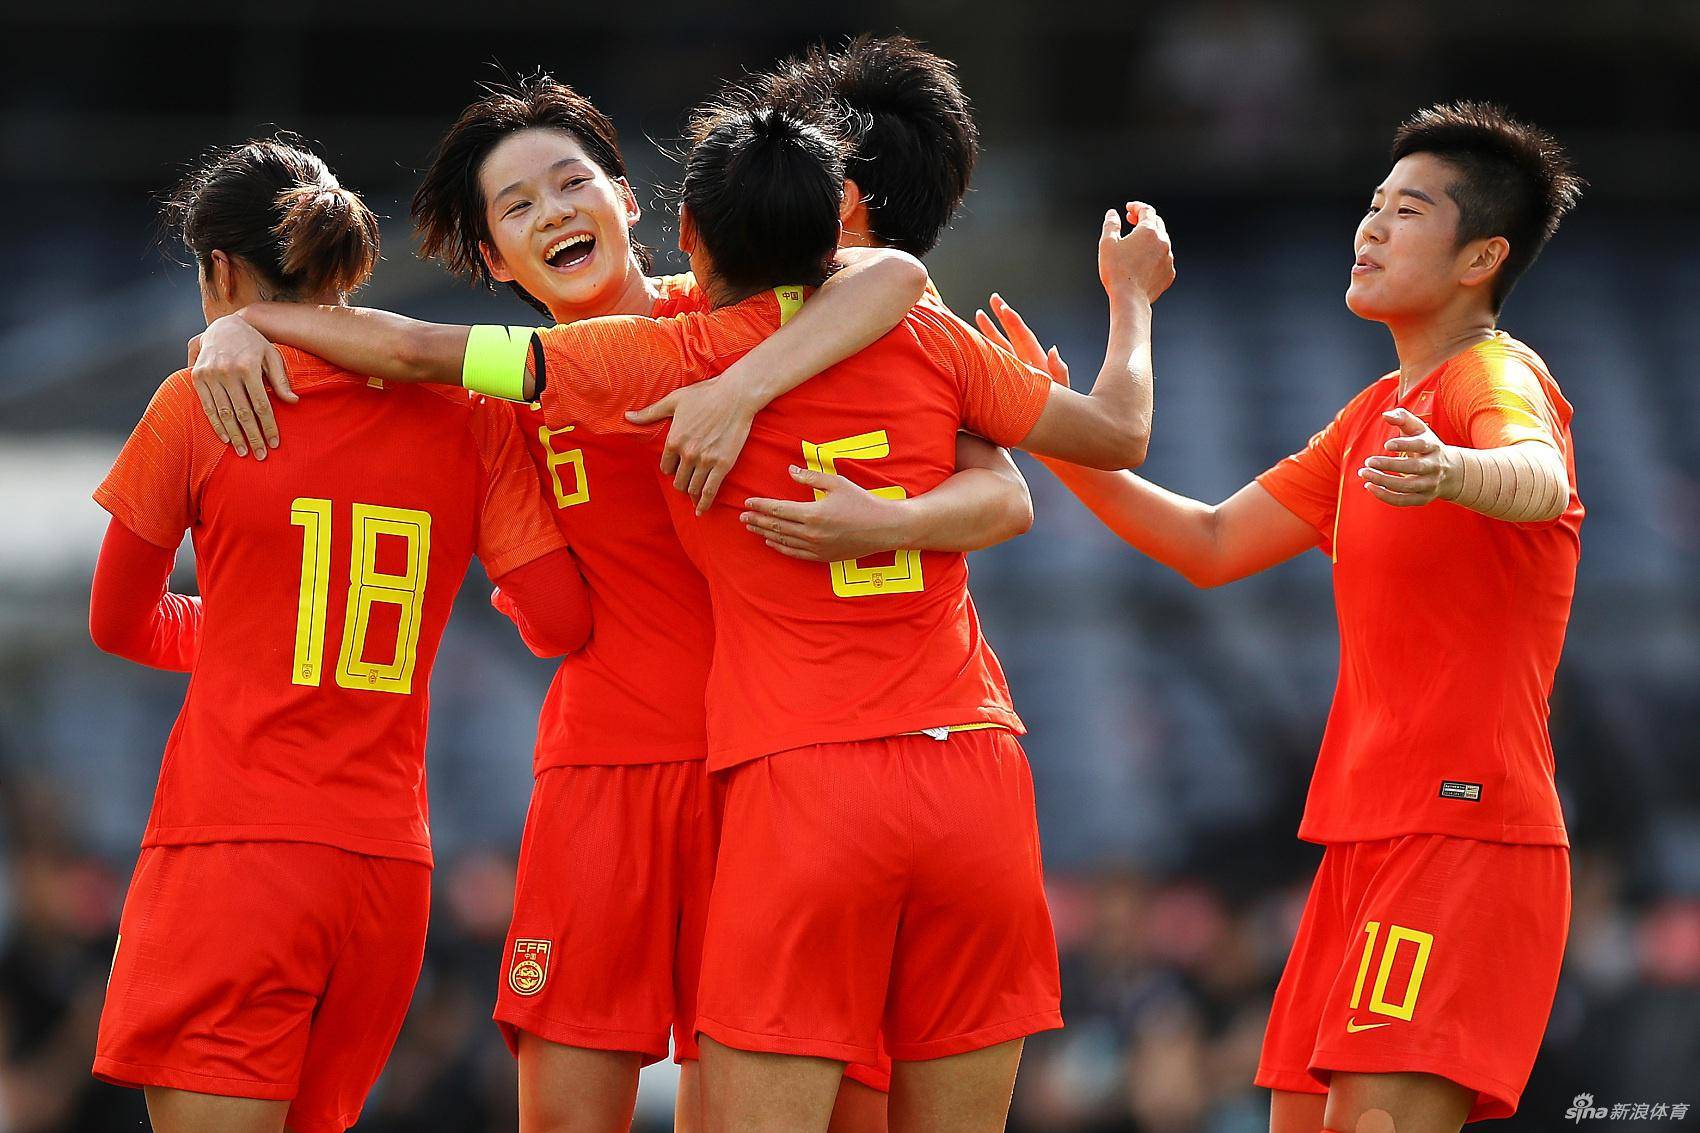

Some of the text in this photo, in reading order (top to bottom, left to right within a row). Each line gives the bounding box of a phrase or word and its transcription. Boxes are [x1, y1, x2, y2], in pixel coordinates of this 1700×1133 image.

[782, 291, 799, 301] 中国
[538, 425, 590, 509] 6
[290, 497, 432, 695] 18
[517, 942, 548, 954] CFA
[1349, 921, 1434, 1022] 10
